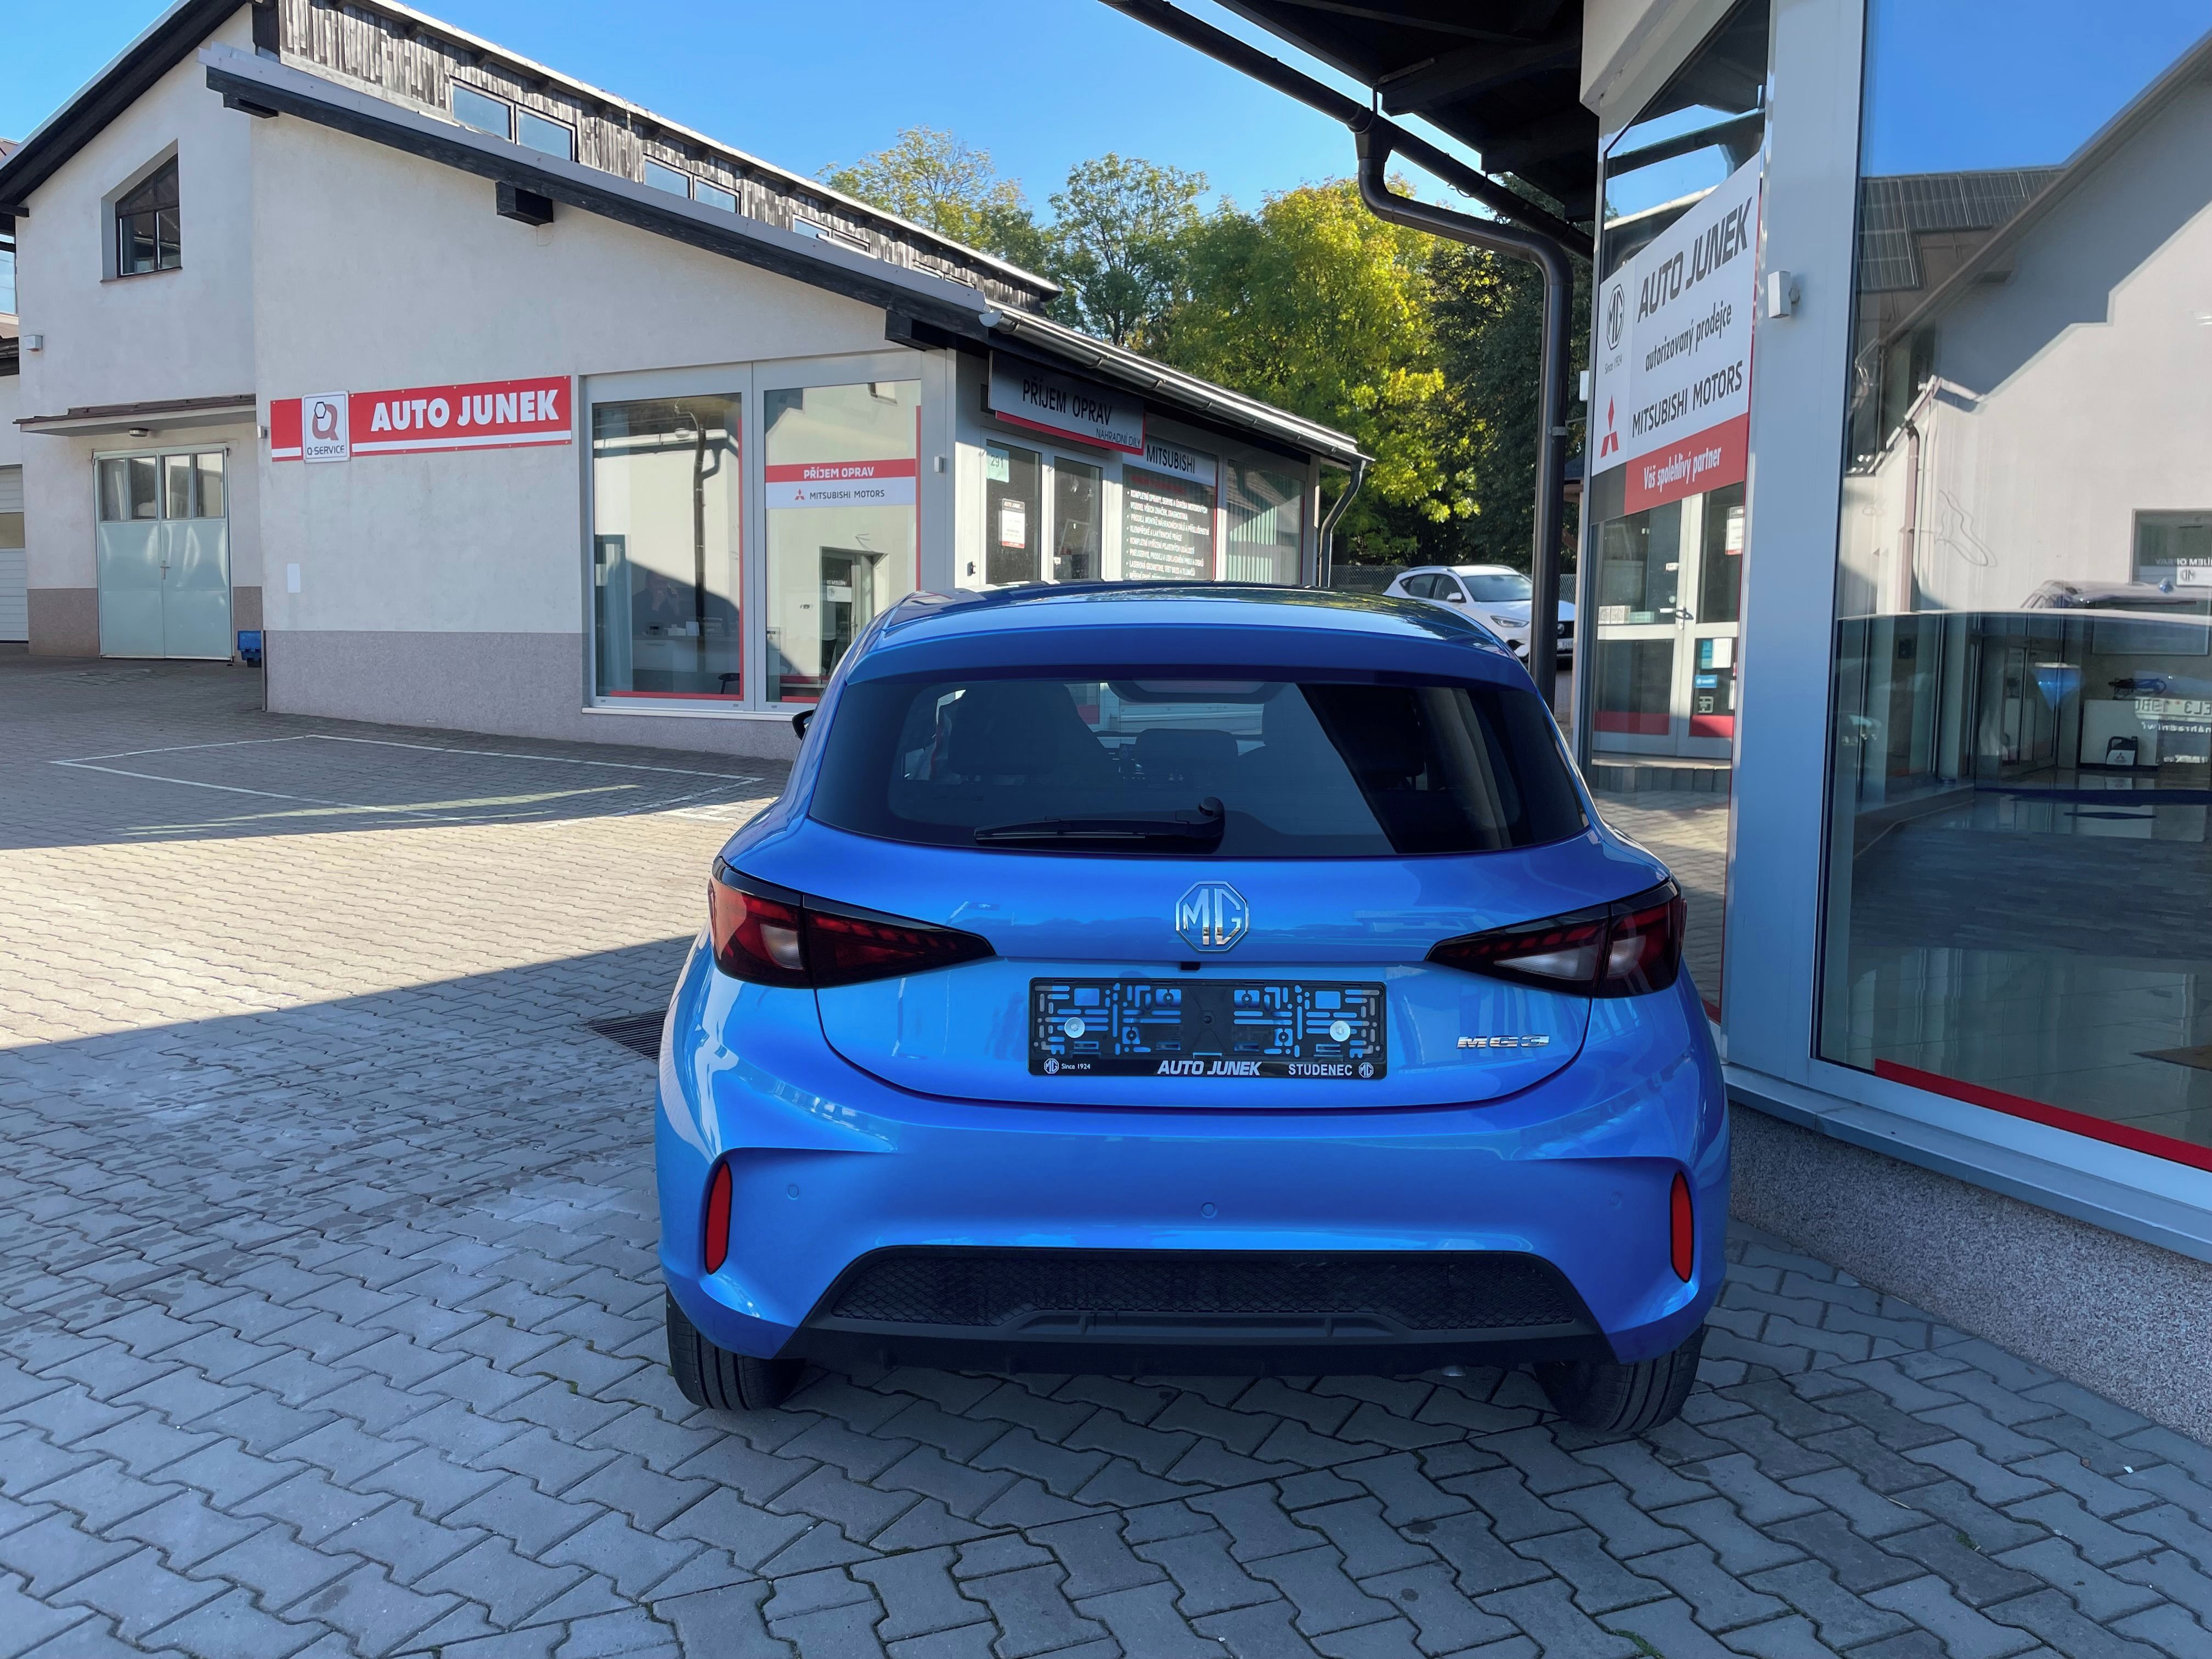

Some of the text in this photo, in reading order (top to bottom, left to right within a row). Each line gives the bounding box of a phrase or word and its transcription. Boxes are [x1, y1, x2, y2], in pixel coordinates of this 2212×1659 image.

[1637, 196, 1752, 323] AUTO JUNEK
[1645, 300, 1732, 372] autorizovaný prodejce
[371, 389, 559, 432] AUTO JUNEK
[1023, 376, 1113, 426] PŘÍJEM OPRAV
[1633, 360, 1743, 438] MITSUBISHI MOTORS
[1096, 427, 1141, 448] NÁHRADNÍ DÍLY
[991, 455, 1003, 469] 291
[1147, 443, 1195, 475] MITSUBISHI
[1644, 447, 1722, 492] Váš spolehlivý partner
[804, 466, 874, 479] PŘÍJEM OPRAV
[810, 489, 885, 500] MITSUBISHI MOTORS
[1178, 884, 1246, 950] MG
[1456, 1035, 1550, 1050] MG3
[1044, 1058, 1059, 1074] MG
[1156, 1060, 1262, 1076] AUTO JUNEK
[1288, 1062, 1374, 1077] STUDENEC MG
